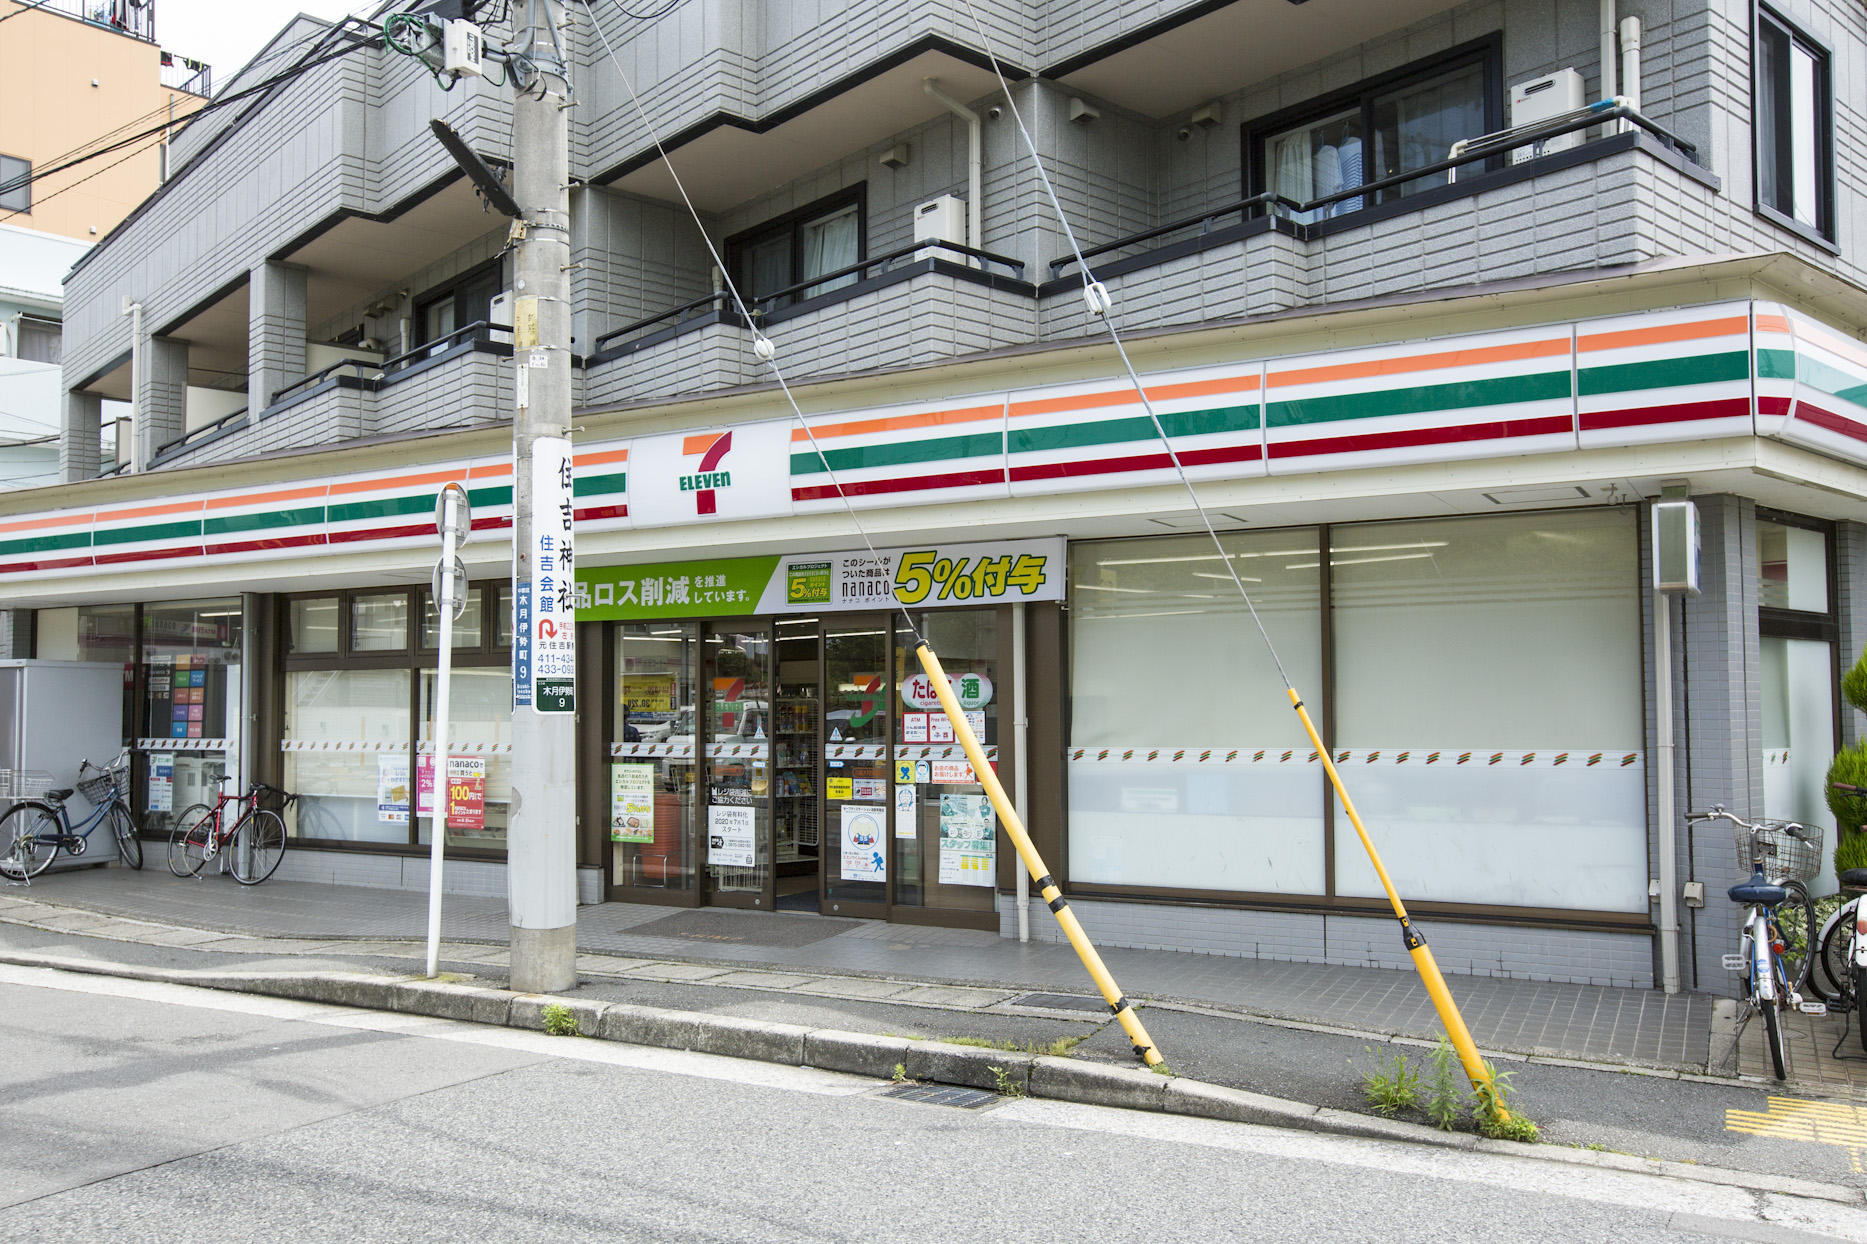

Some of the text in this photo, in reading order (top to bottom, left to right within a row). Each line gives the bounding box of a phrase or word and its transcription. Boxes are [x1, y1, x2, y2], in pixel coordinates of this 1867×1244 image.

[842, 556, 891, 567] このシールが
[540, 534, 554, 613] 住吉会館
[842, 567, 890, 579] ついた商品は
[892, 549, 1047, 605] 5%付与
[694, 574, 727, 588] を推進
[790, 577, 827, 598] 5%付与
[574, 575, 690, 610] 品ロス削減
[842, 580, 890, 597] nanaco
[694, 589, 750, 604] しています。
[539, 641, 574, 650] 元住吉駅
[519, 666, 527, 679] 9
[961, 678, 980, 699] 酒
[559, 698, 566, 707] 9
[716, 810, 748, 818] レジ袋有料化
